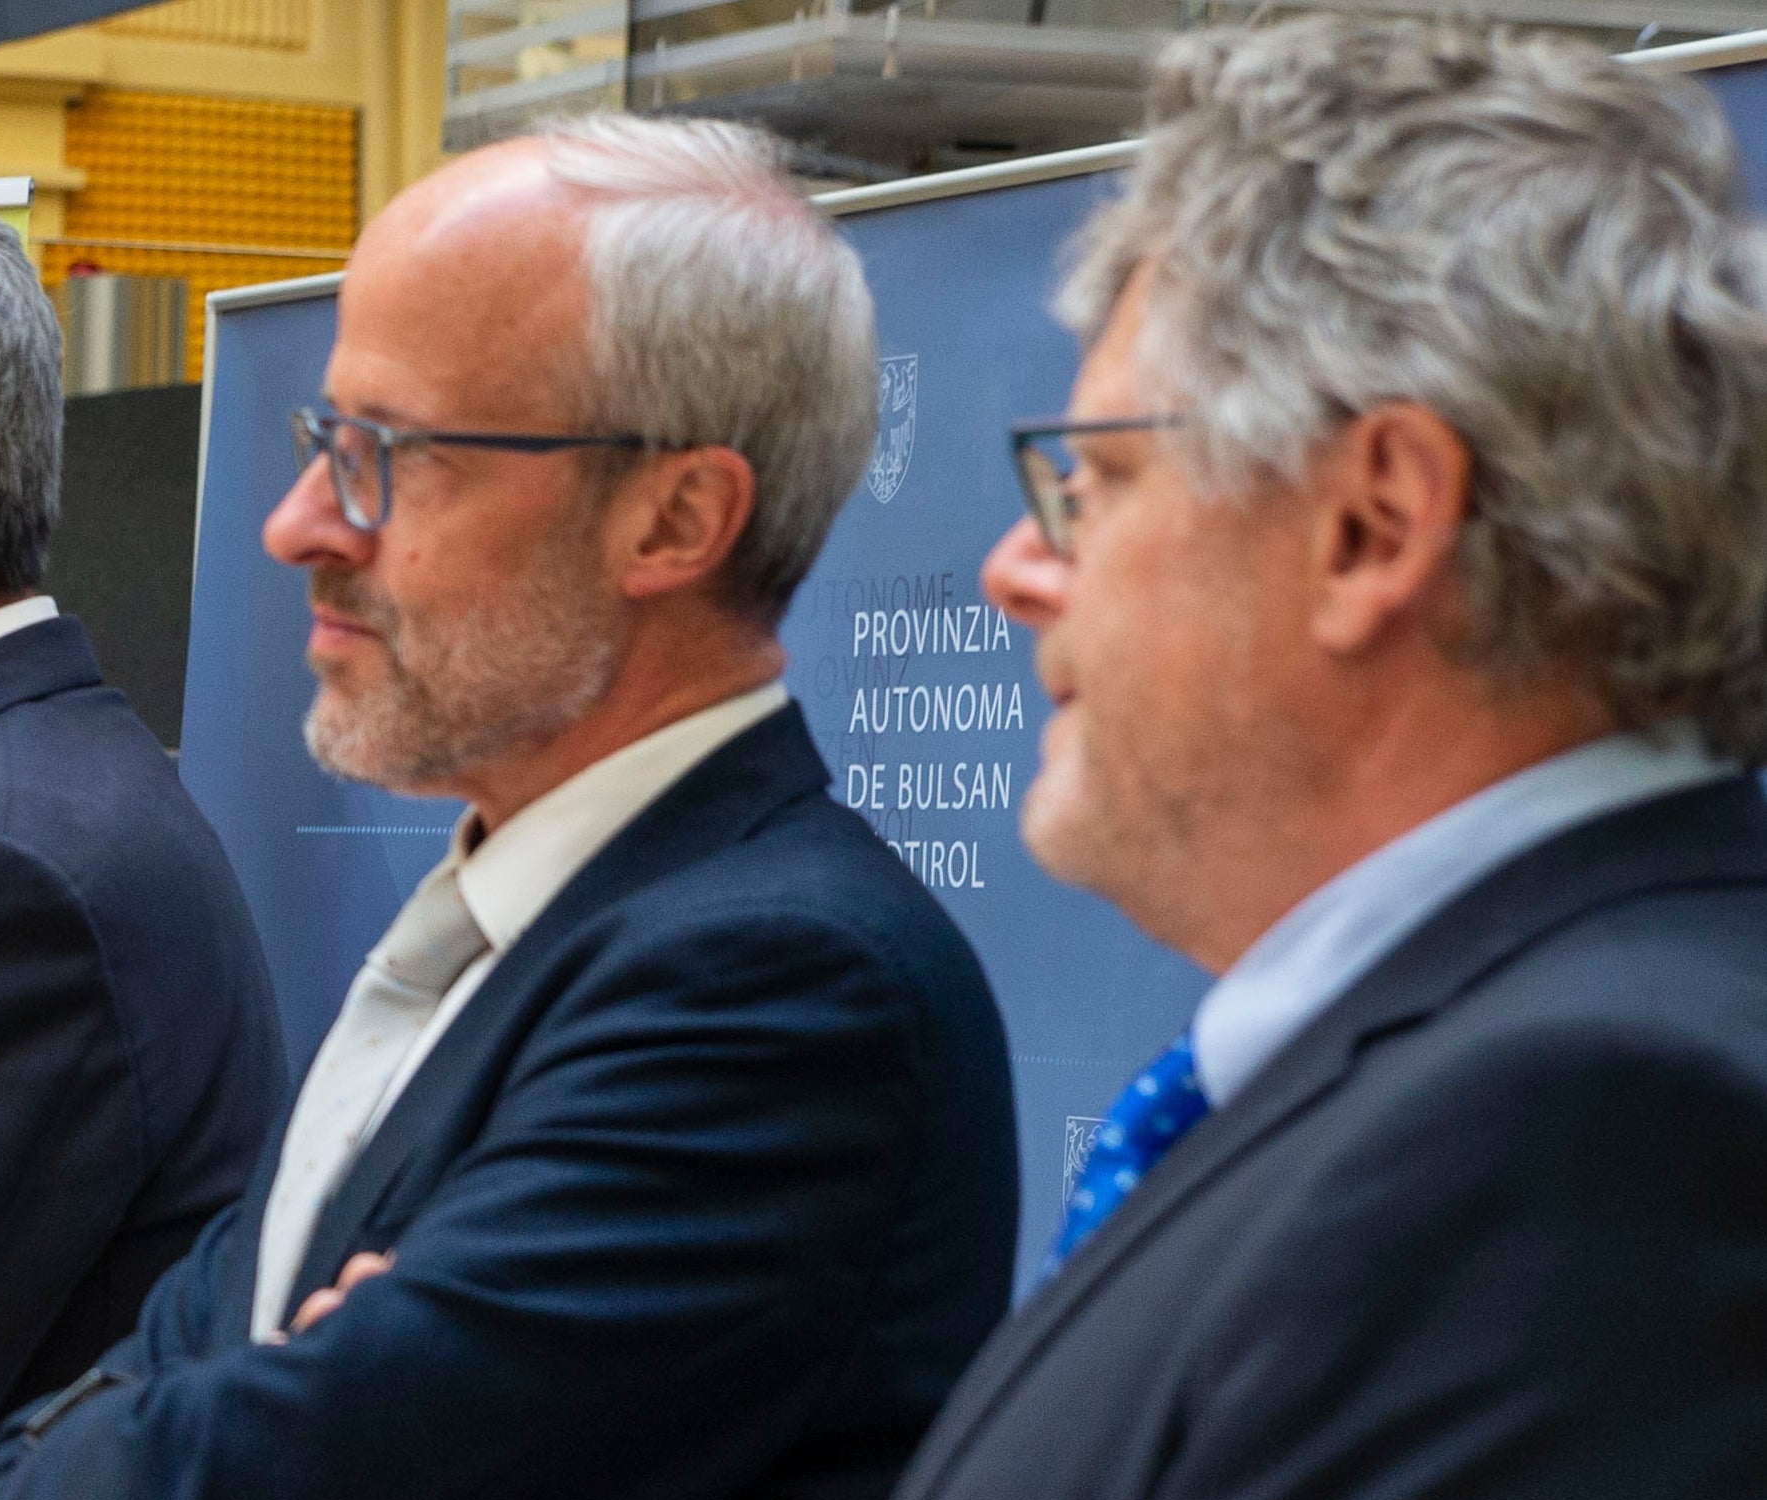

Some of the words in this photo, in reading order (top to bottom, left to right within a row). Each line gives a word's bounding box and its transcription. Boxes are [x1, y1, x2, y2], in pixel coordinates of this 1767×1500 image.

[853, 604, 1011, 657] PROVINZIA
[848, 682, 1024, 734] AUTONOMA
[846, 763, 885, 810] DE
[897, 762, 1011, 810] BULSAN
[886, 840, 986, 889] TIROL
